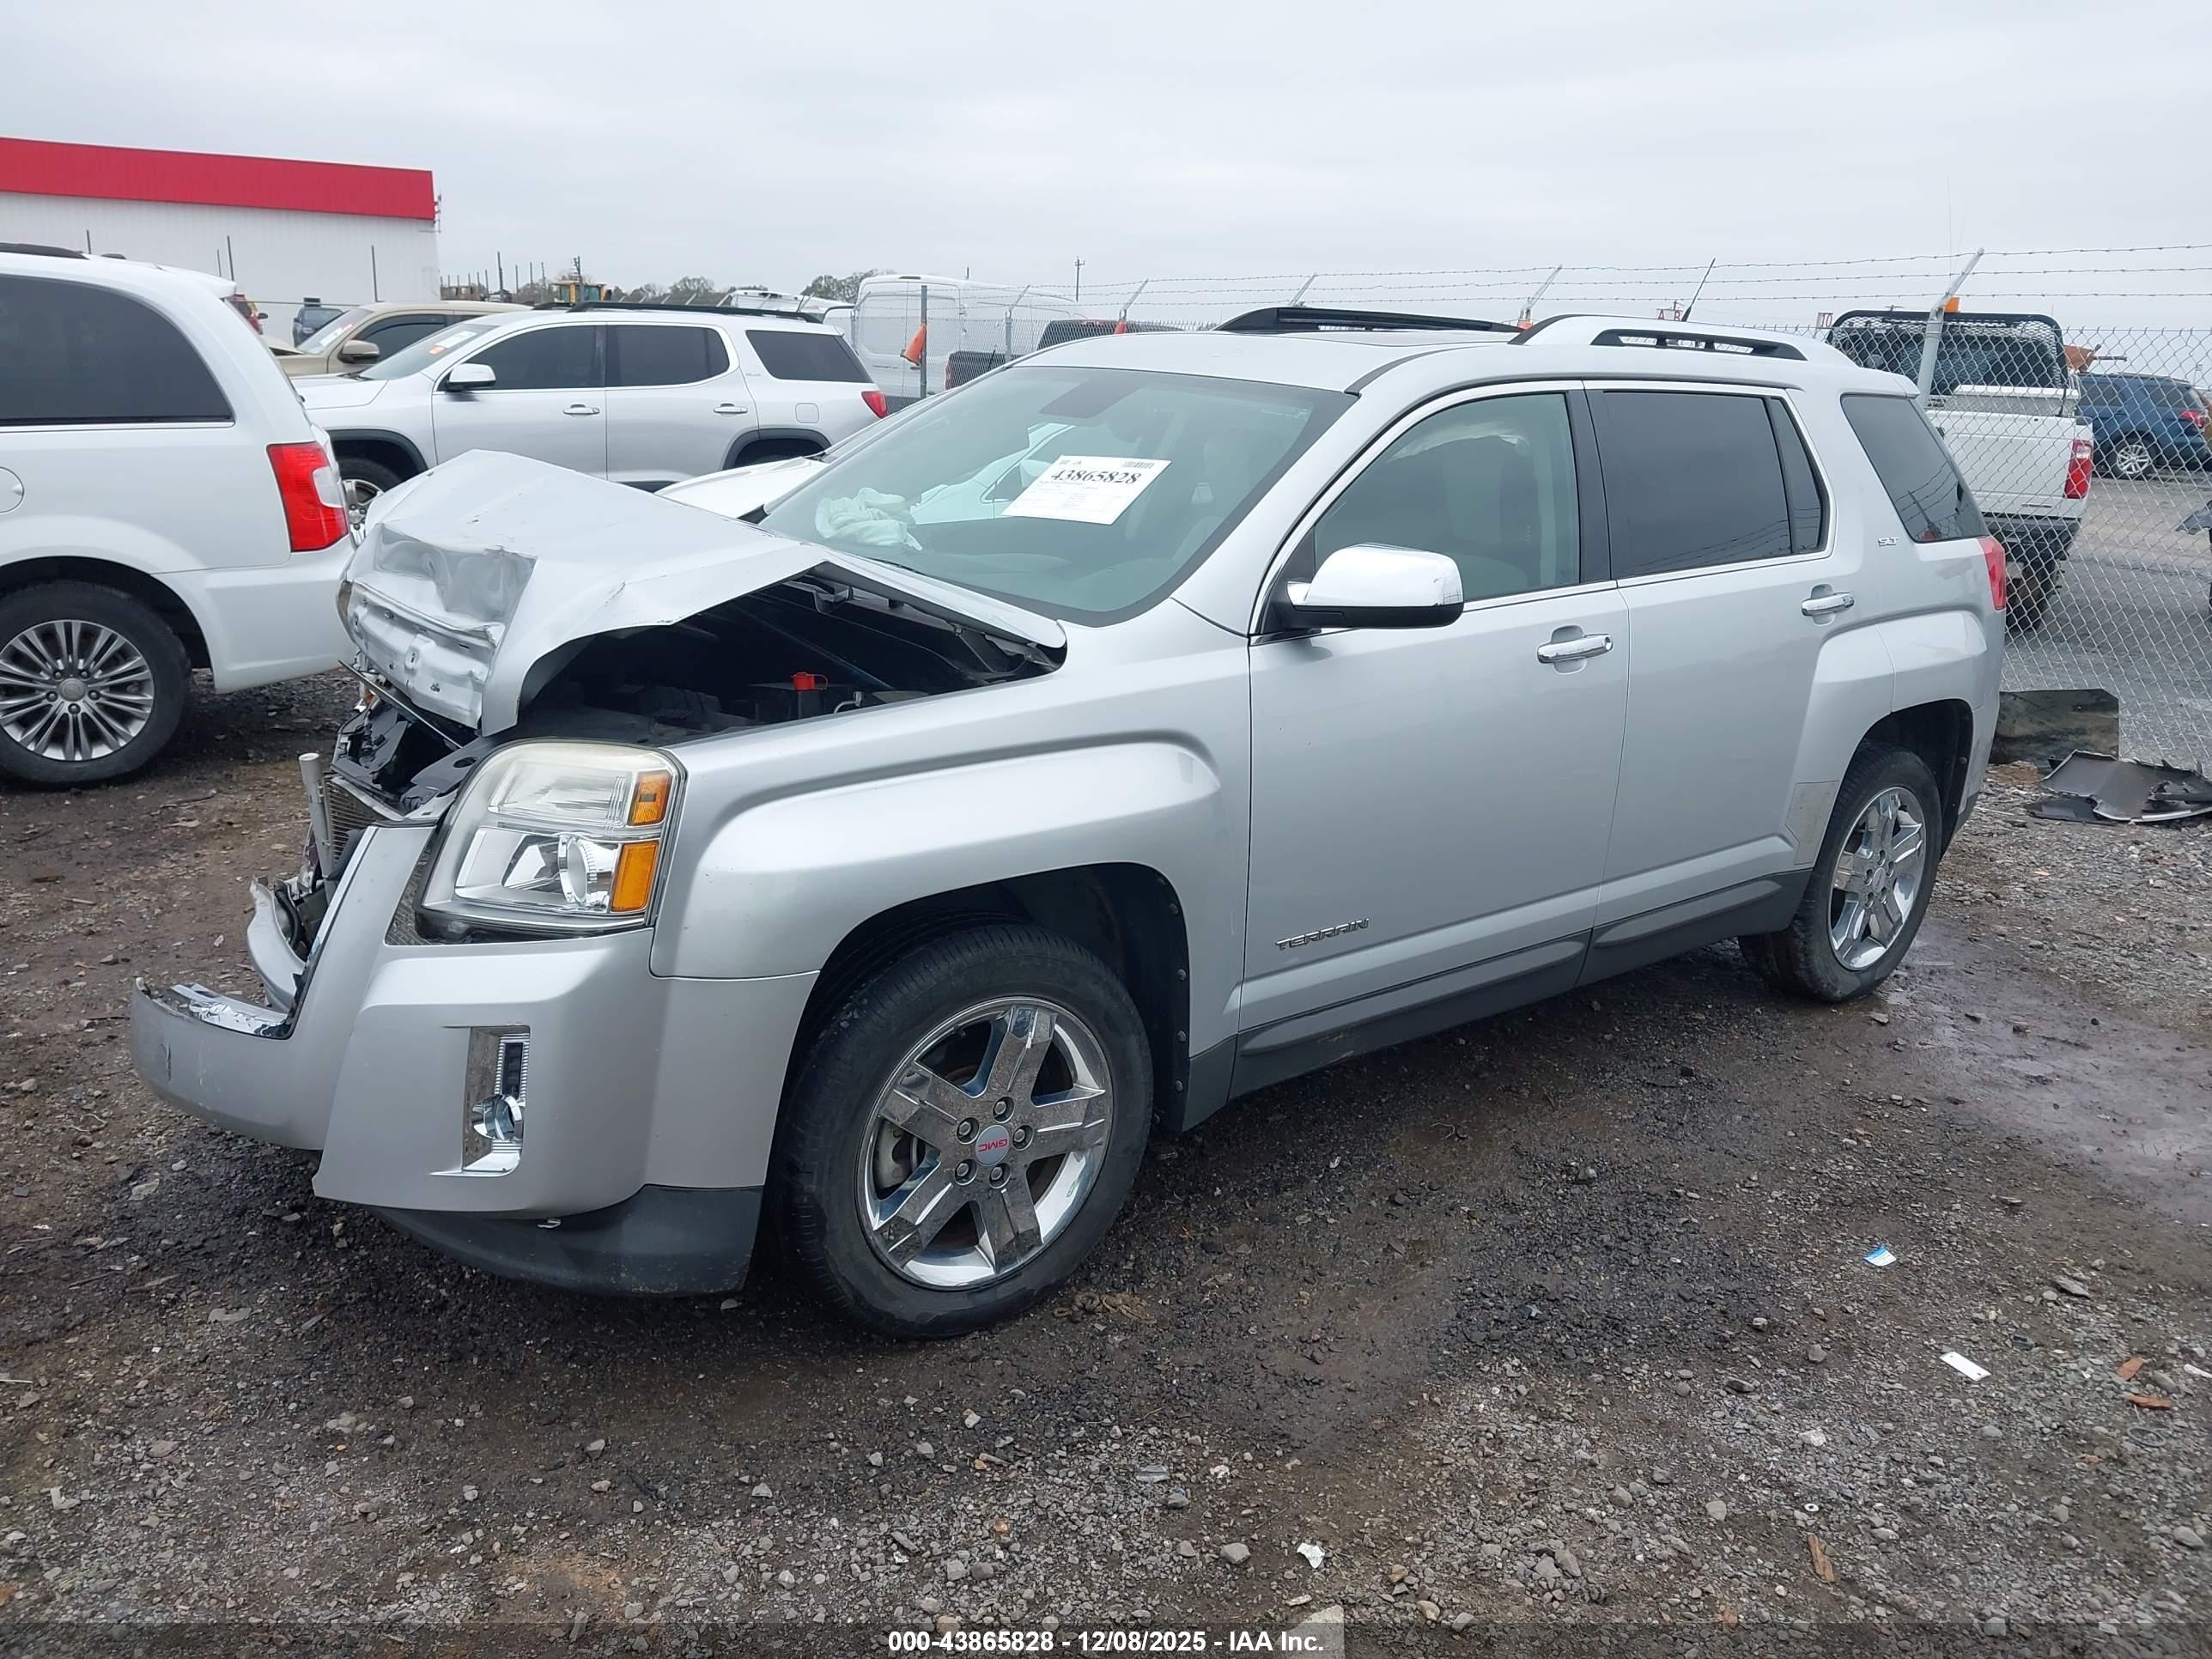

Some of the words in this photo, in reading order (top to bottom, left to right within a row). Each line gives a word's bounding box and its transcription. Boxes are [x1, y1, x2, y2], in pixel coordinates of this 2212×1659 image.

[1051, 469, 1141, 484] 43865828
[1274, 917, 1370, 951] TERRAIN
[978, 1139, 1008, 1152] GMC
